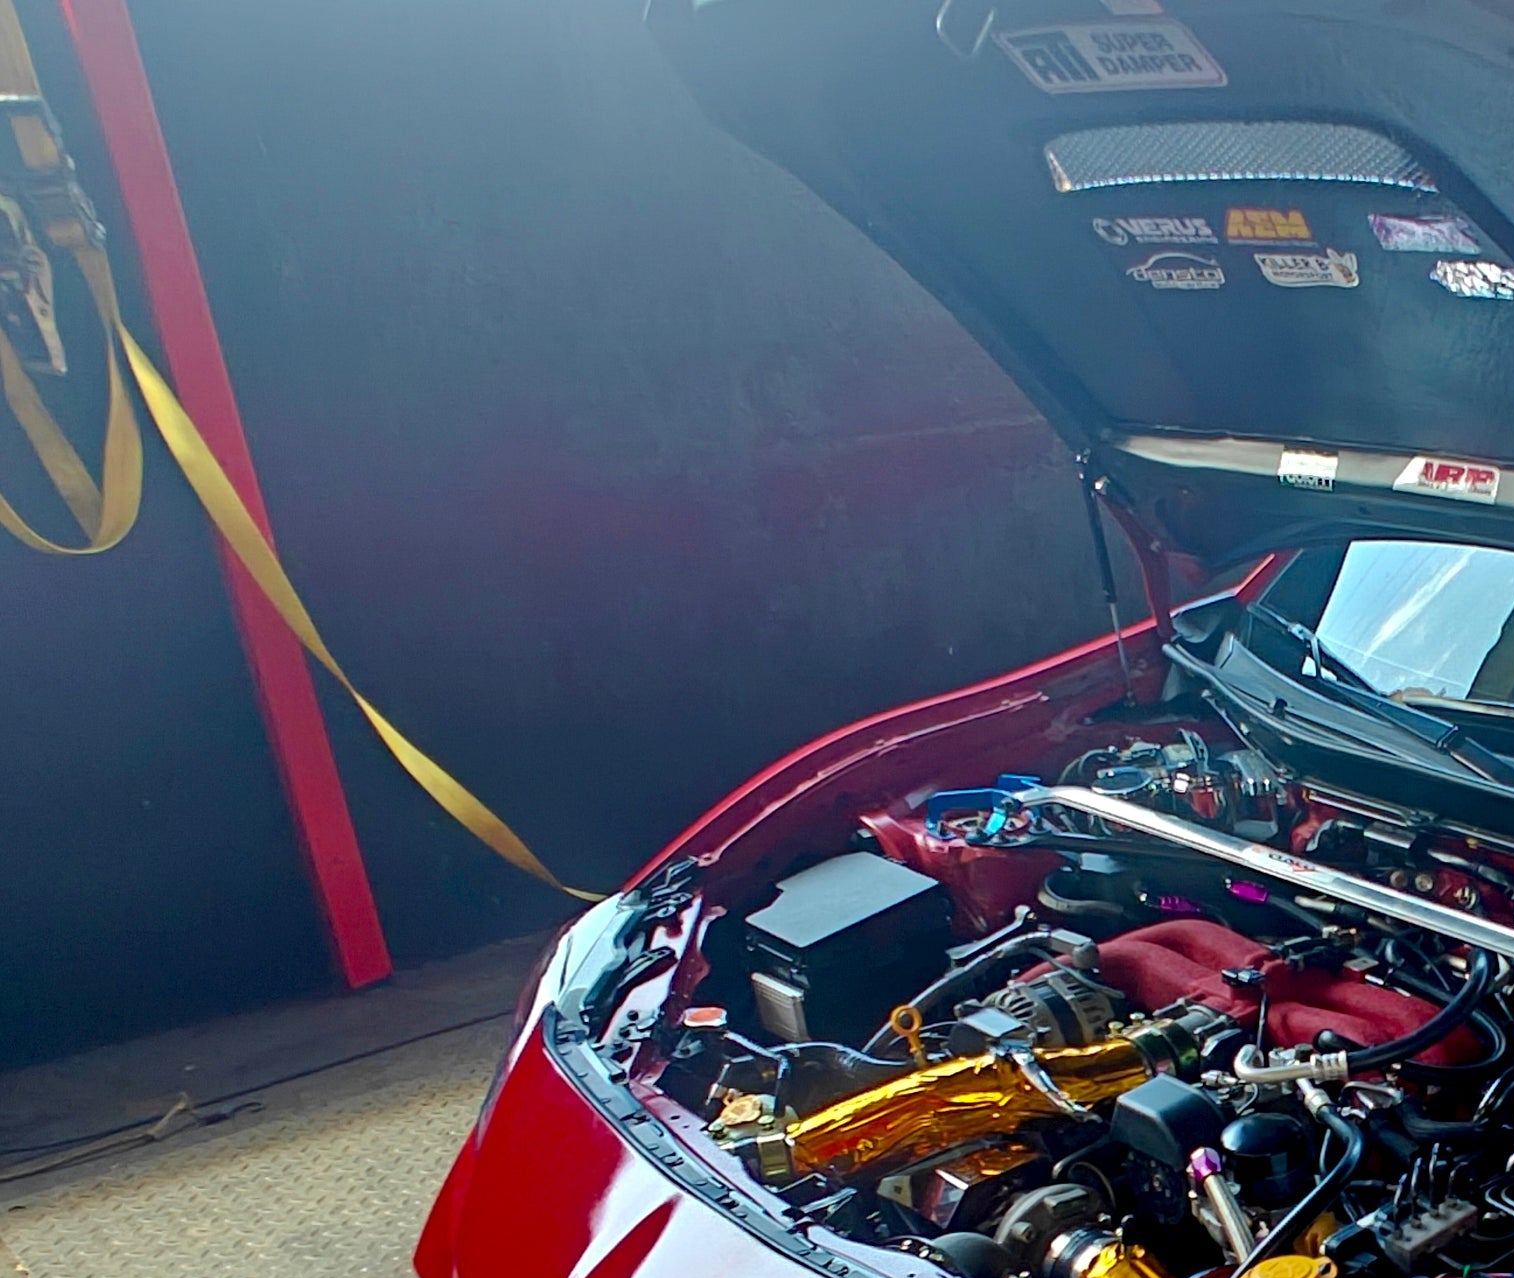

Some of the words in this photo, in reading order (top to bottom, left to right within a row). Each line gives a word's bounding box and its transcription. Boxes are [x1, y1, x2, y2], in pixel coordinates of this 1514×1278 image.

[1090, 32, 1175, 53] SUPER
[1098, 53, 1203, 76] DAMPER
[1114, 218, 1213, 236] VERUS
